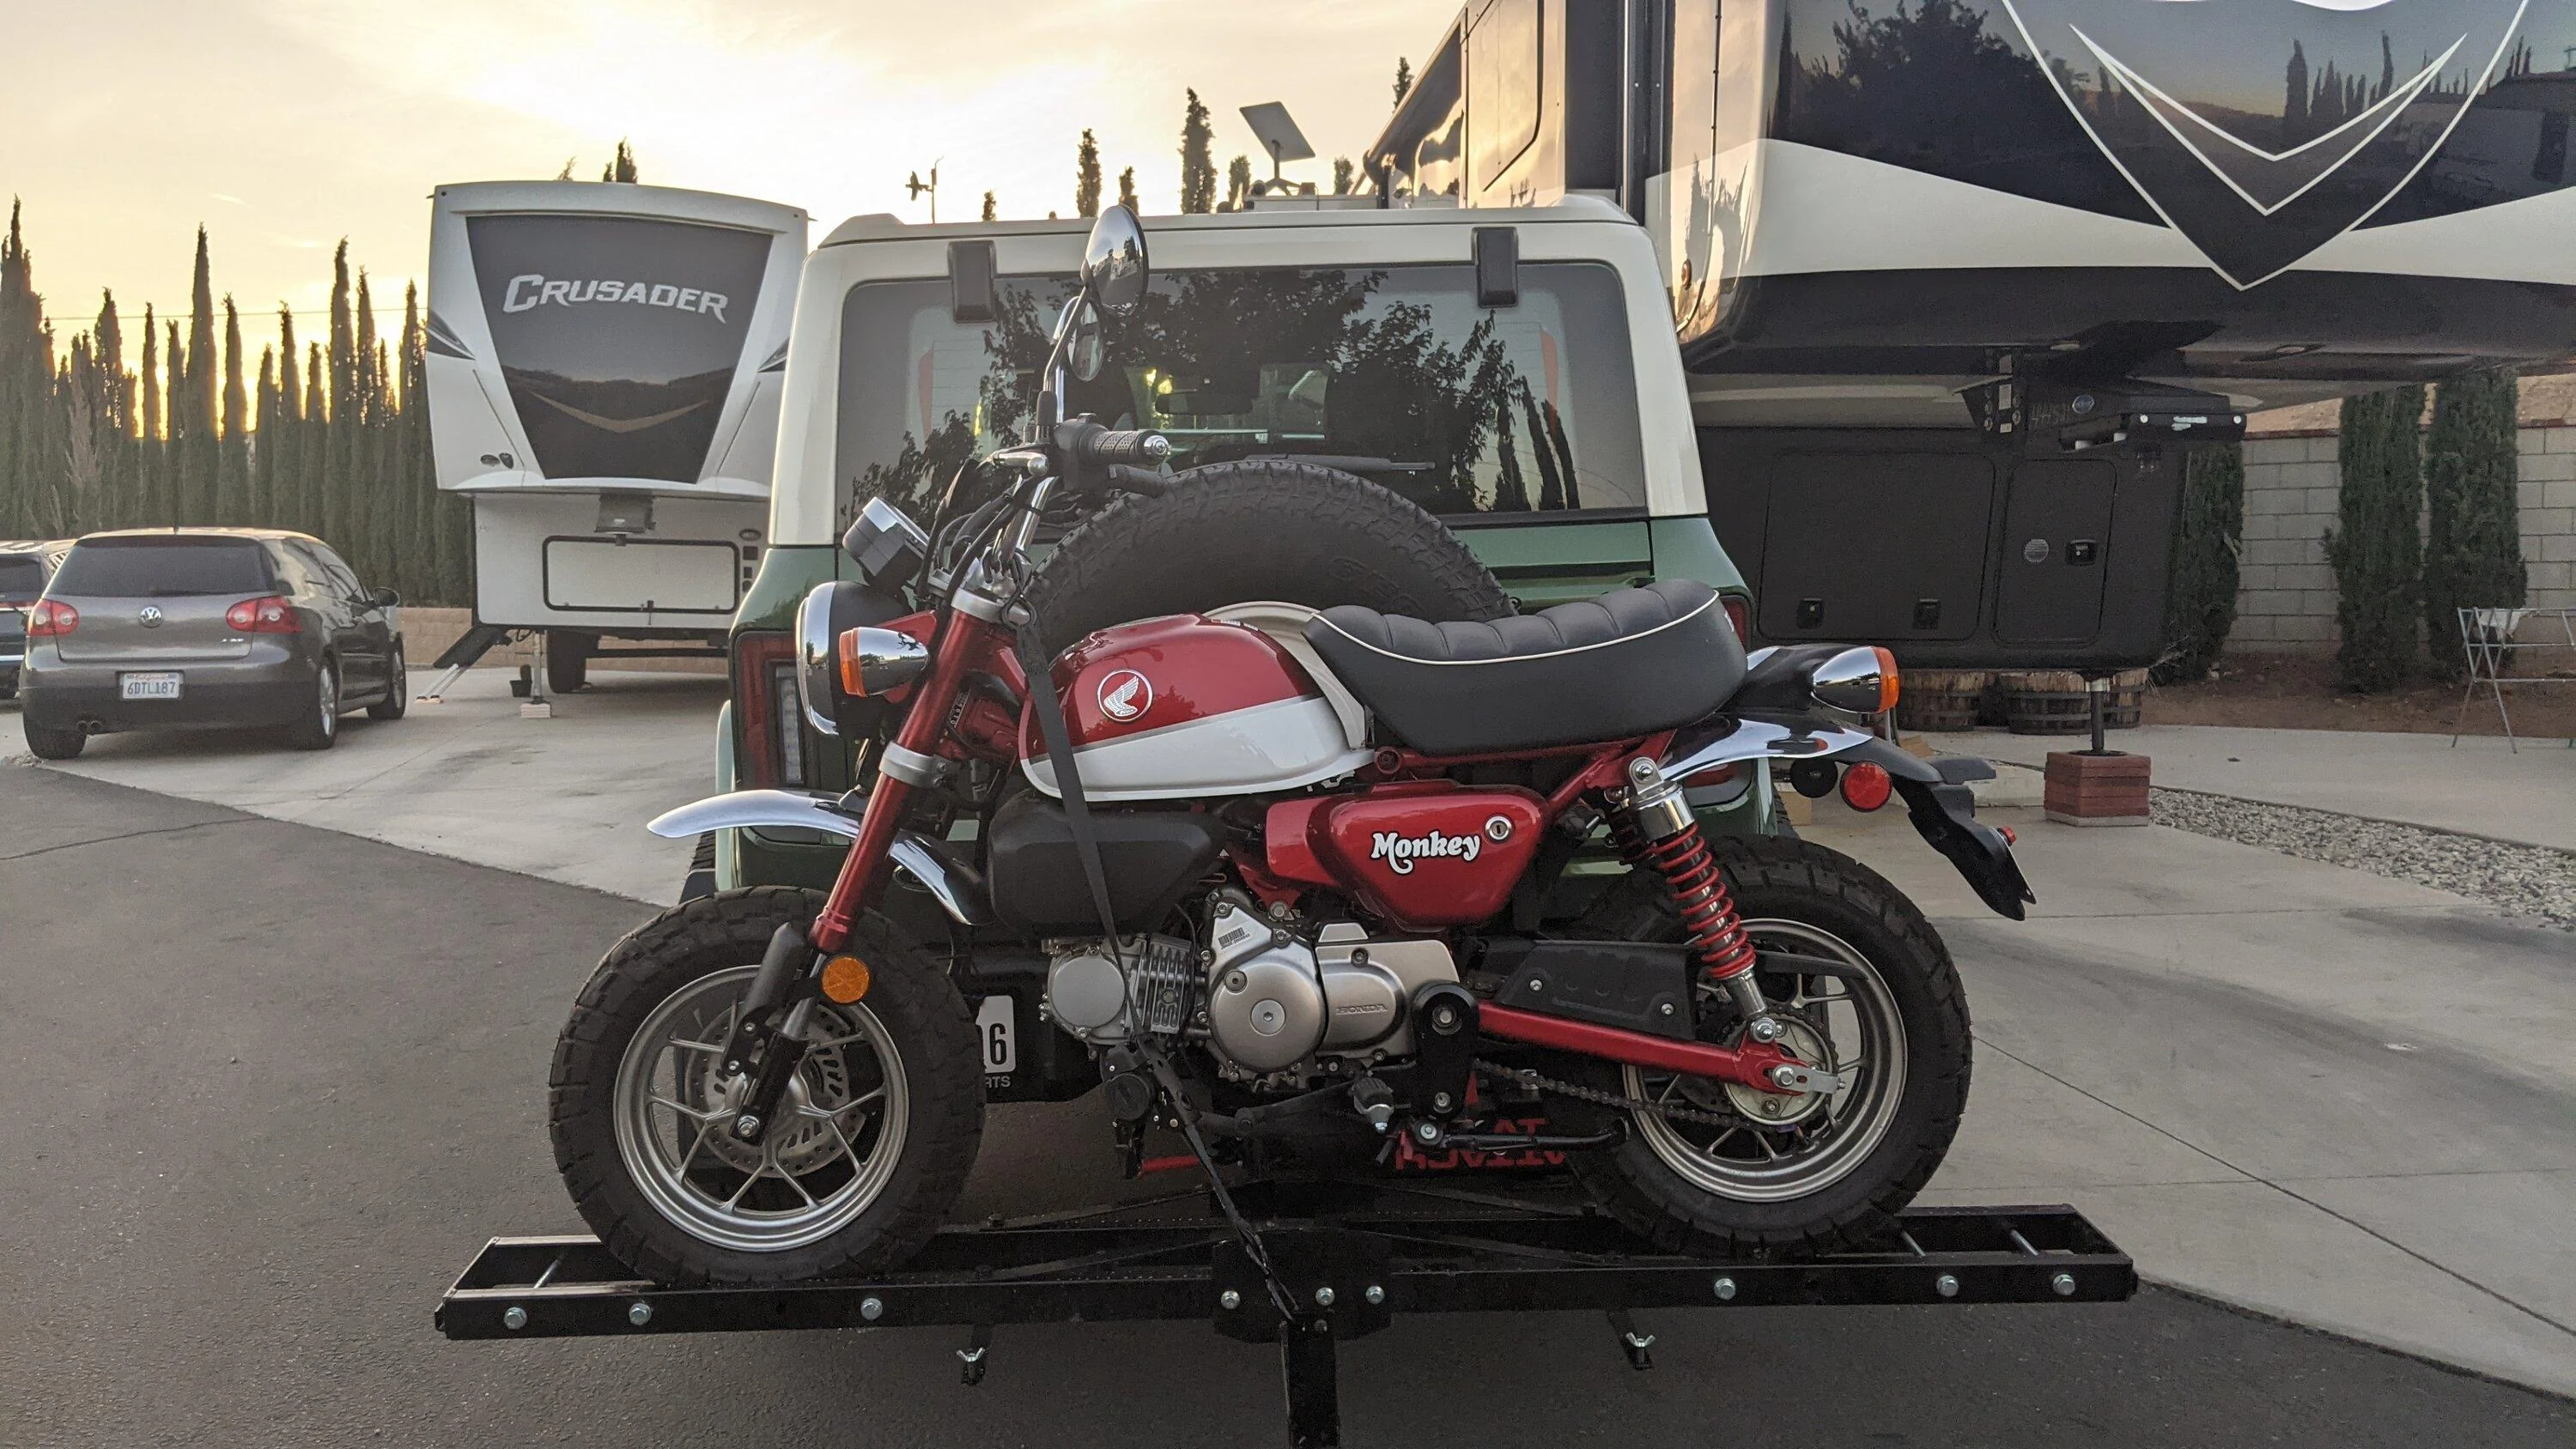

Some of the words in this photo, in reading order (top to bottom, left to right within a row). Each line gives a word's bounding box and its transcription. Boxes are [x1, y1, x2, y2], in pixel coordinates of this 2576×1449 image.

[503, 274, 728, 324] CRUSADER
[127, 682, 176, 694] 6DTL187
[1370, 830, 1480, 874] Monkey
[1335, 1003, 1388, 1016] HONDA
